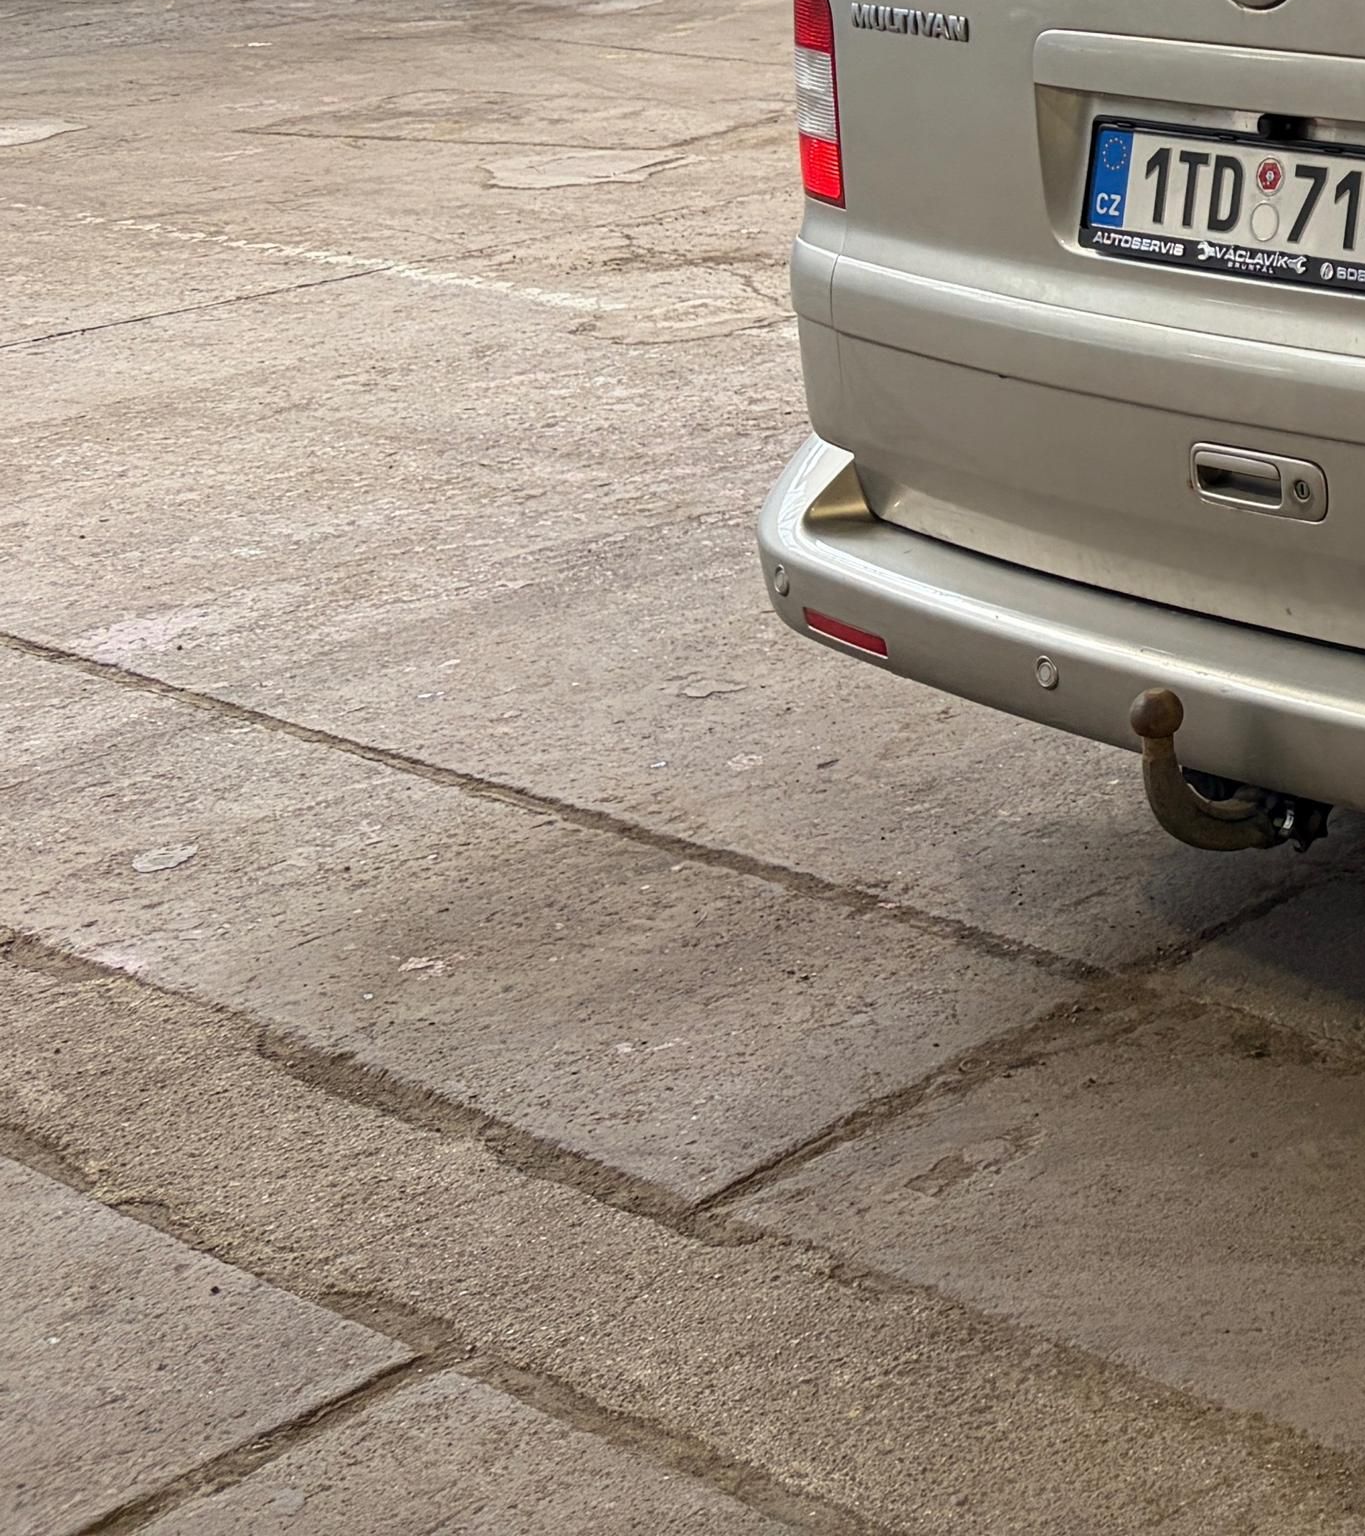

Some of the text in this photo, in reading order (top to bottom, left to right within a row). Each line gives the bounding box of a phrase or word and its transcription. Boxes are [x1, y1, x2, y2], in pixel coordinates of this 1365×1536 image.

[850, 2, 970, 43] MULTIVAN
[1096, 193, 1121, 217] CZ
[1144, 147, 1244, 232] 1TD
[1093, 231, 1184, 256] AUTOSERVIS
[1214, 246, 1288, 269] VÁCLAVÍK
